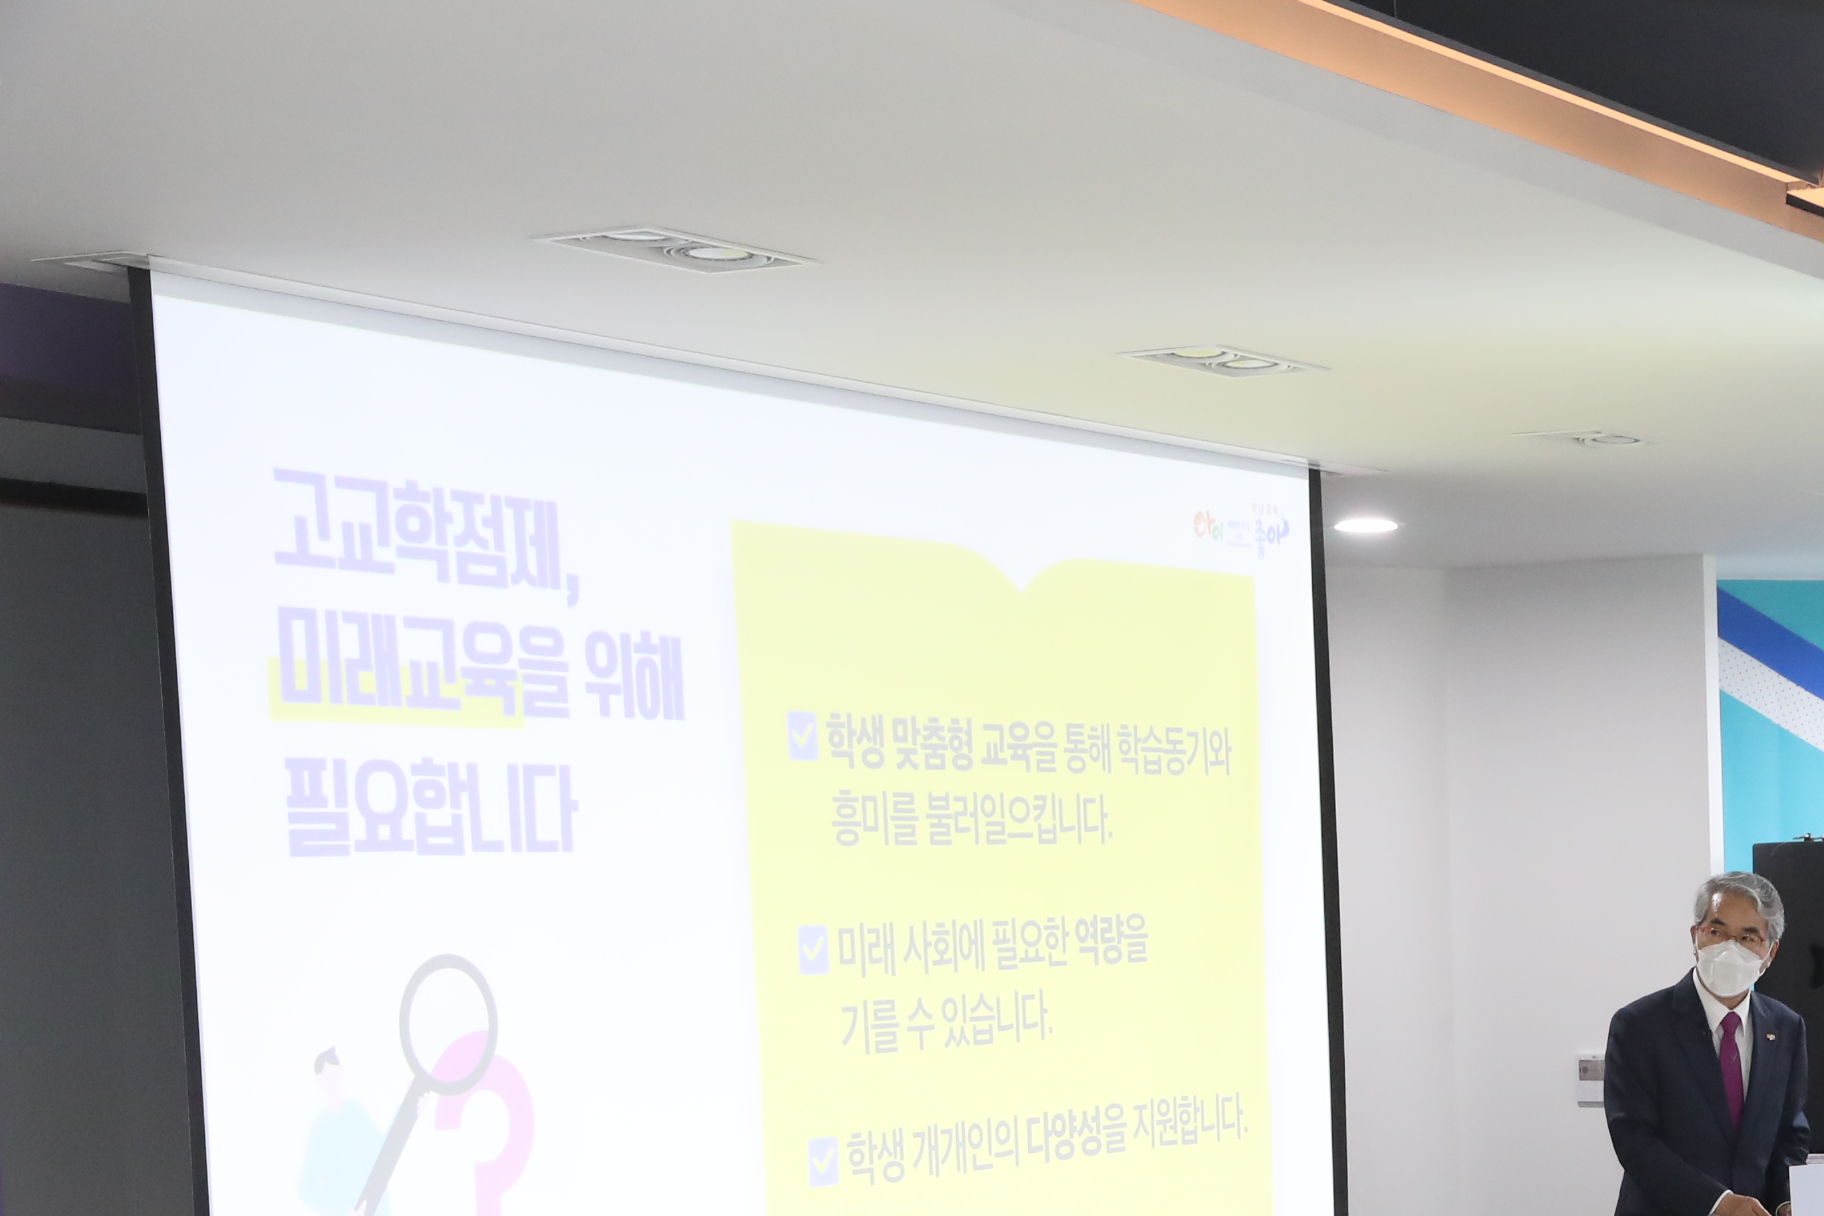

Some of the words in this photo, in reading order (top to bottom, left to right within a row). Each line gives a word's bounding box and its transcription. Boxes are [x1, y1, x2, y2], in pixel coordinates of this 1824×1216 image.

[273, 467, 580, 607] 고교학점제,
[277, 606, 570, 719] 미래교육을
[584, 630, 686, 721] 위해
[825, 712, 885, 769] 학생
[891, 714, 974, 772] 맞춤형
[981, 720, 1058, 773] 교육을
[1063, 721, 1112, 775] 통해
[1117, 723, 1232, 776] 학습동기와
[284, 756, 580, 858] 필요합니다
[831, 789, 919, 847] 흥미를
[925, 791, 1113, 846] 불러일으킵니다.
[838, 921, 897, 979] 미래
[902, 918, 986, 976] 사회에
[991, 914, 1070, 972] 필요한
[1074, 912, 1149, 967] 역량을
[840, 998, 900, 1056] 기를
[906, 996, 936, 1052] 수
[940, 988, 1054, 1049] 있습니다.
[846, 1127, 906, 1187] 학생
[911, 1113, 1020, 1179] 개개인의
[1026, 1102, 1128, 1164] 다양성을
[1132, 1091, 1249, 1149] 지원합니다.
